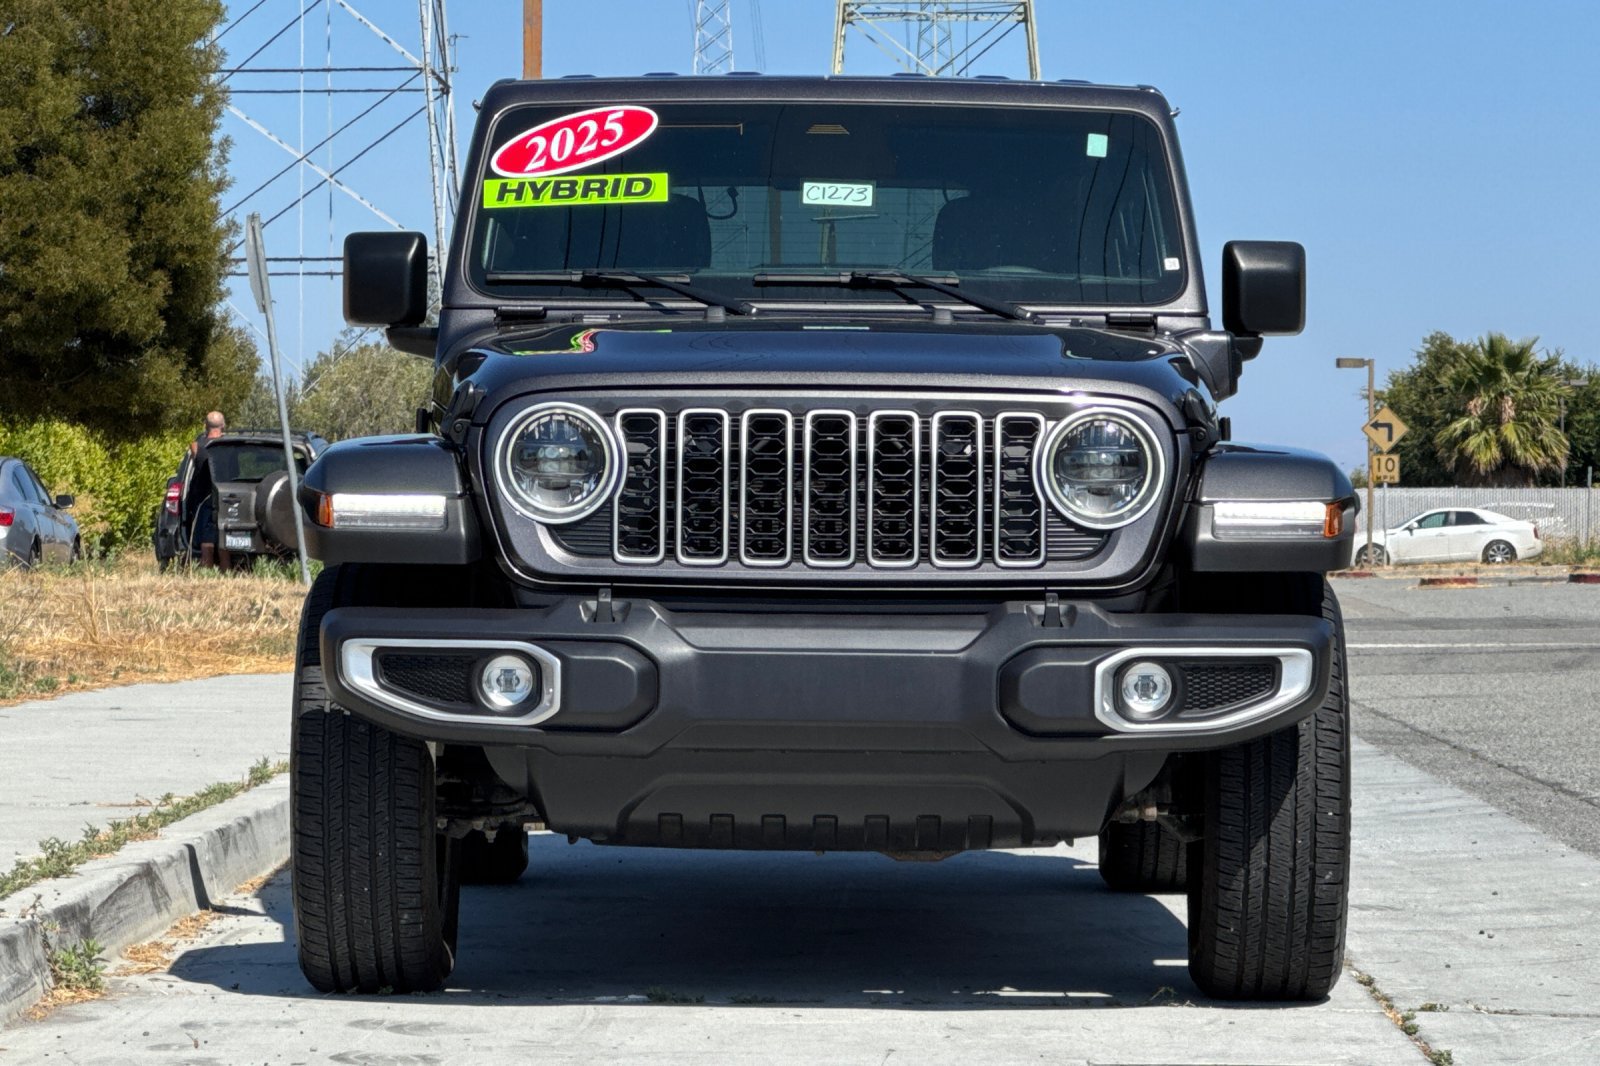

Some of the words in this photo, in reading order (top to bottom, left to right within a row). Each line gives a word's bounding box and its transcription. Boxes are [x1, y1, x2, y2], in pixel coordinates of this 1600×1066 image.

[524, 111, 625, 172] 2025
[496, 177, 655, 203] HYBRID
[806, 185, 868, 202] C1273
[1376, 457, 1395, 472] 10
